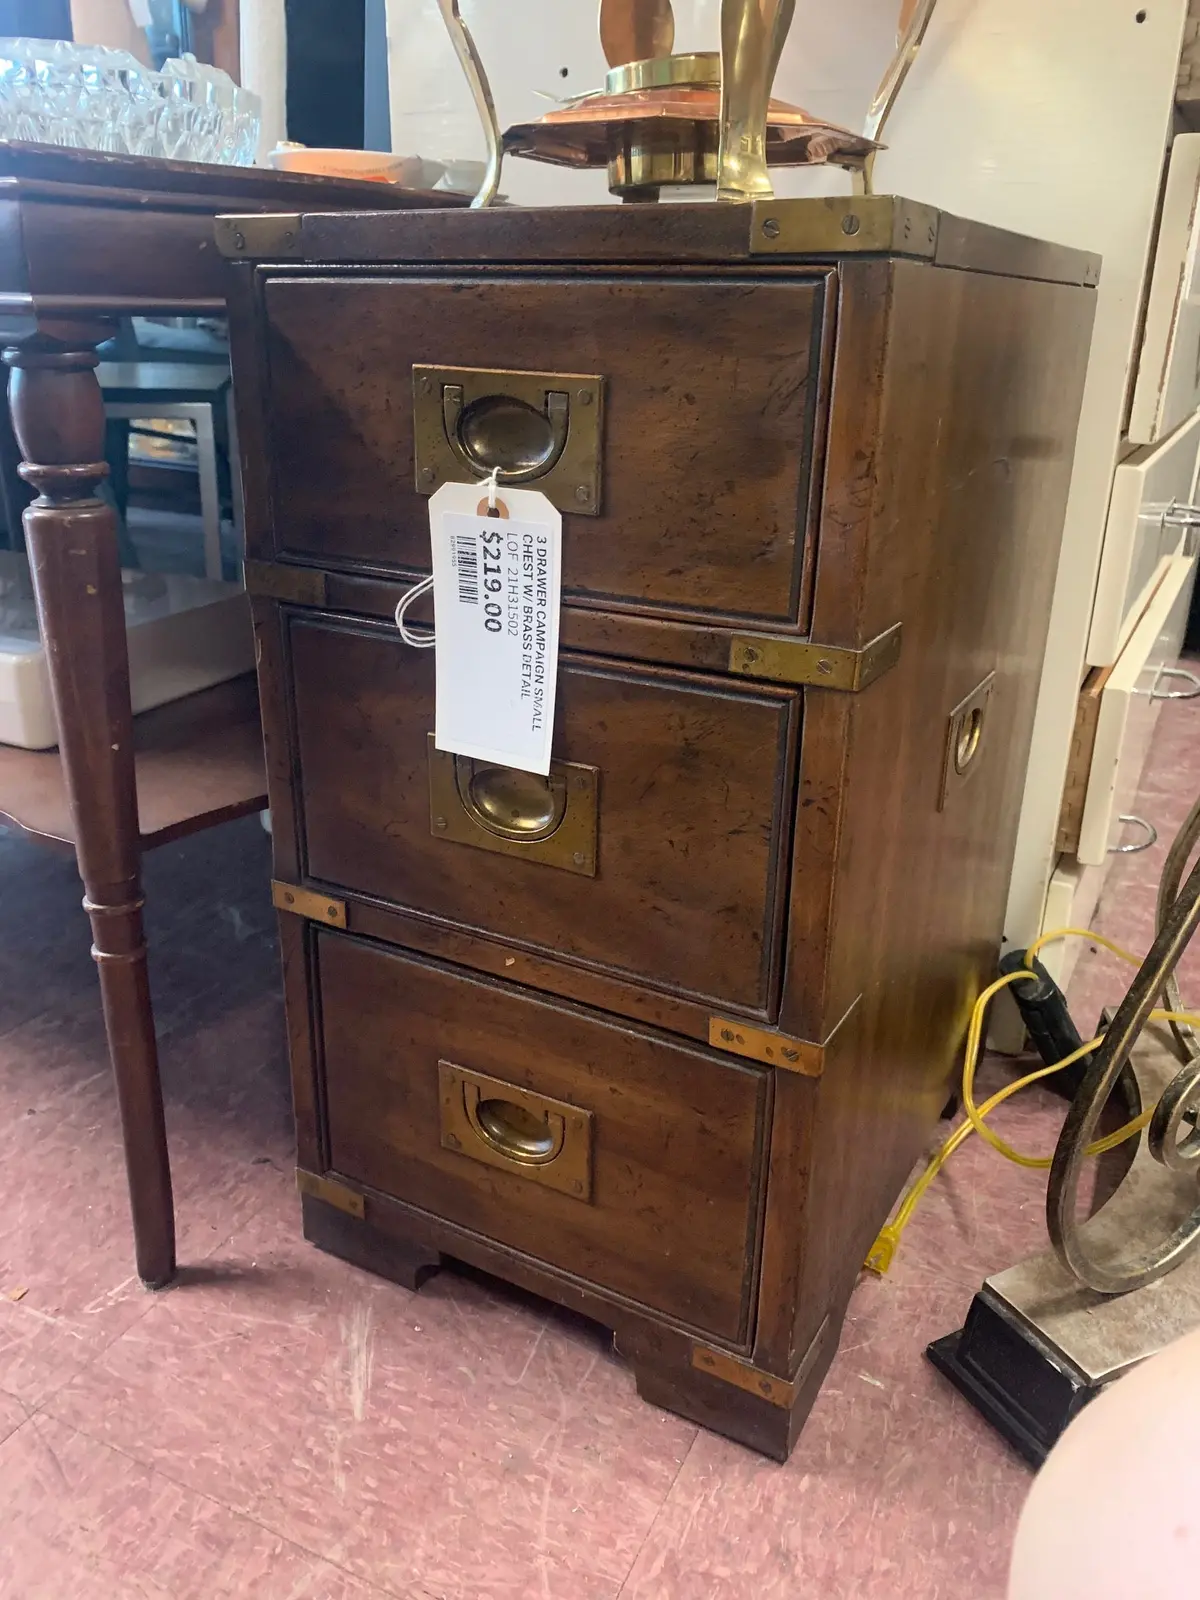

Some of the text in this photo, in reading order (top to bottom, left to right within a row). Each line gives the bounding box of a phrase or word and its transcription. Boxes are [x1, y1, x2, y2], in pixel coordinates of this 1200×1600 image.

[479, 530, 502, 633] $219.00
[507, 533, 519, 637] LOF 21H31502
[520, 534, 534, 700] CHEST W/ BRASS DETAIL
[532, 536, 547, 732] 3 DRAWER CAMPAIGN SMALL
